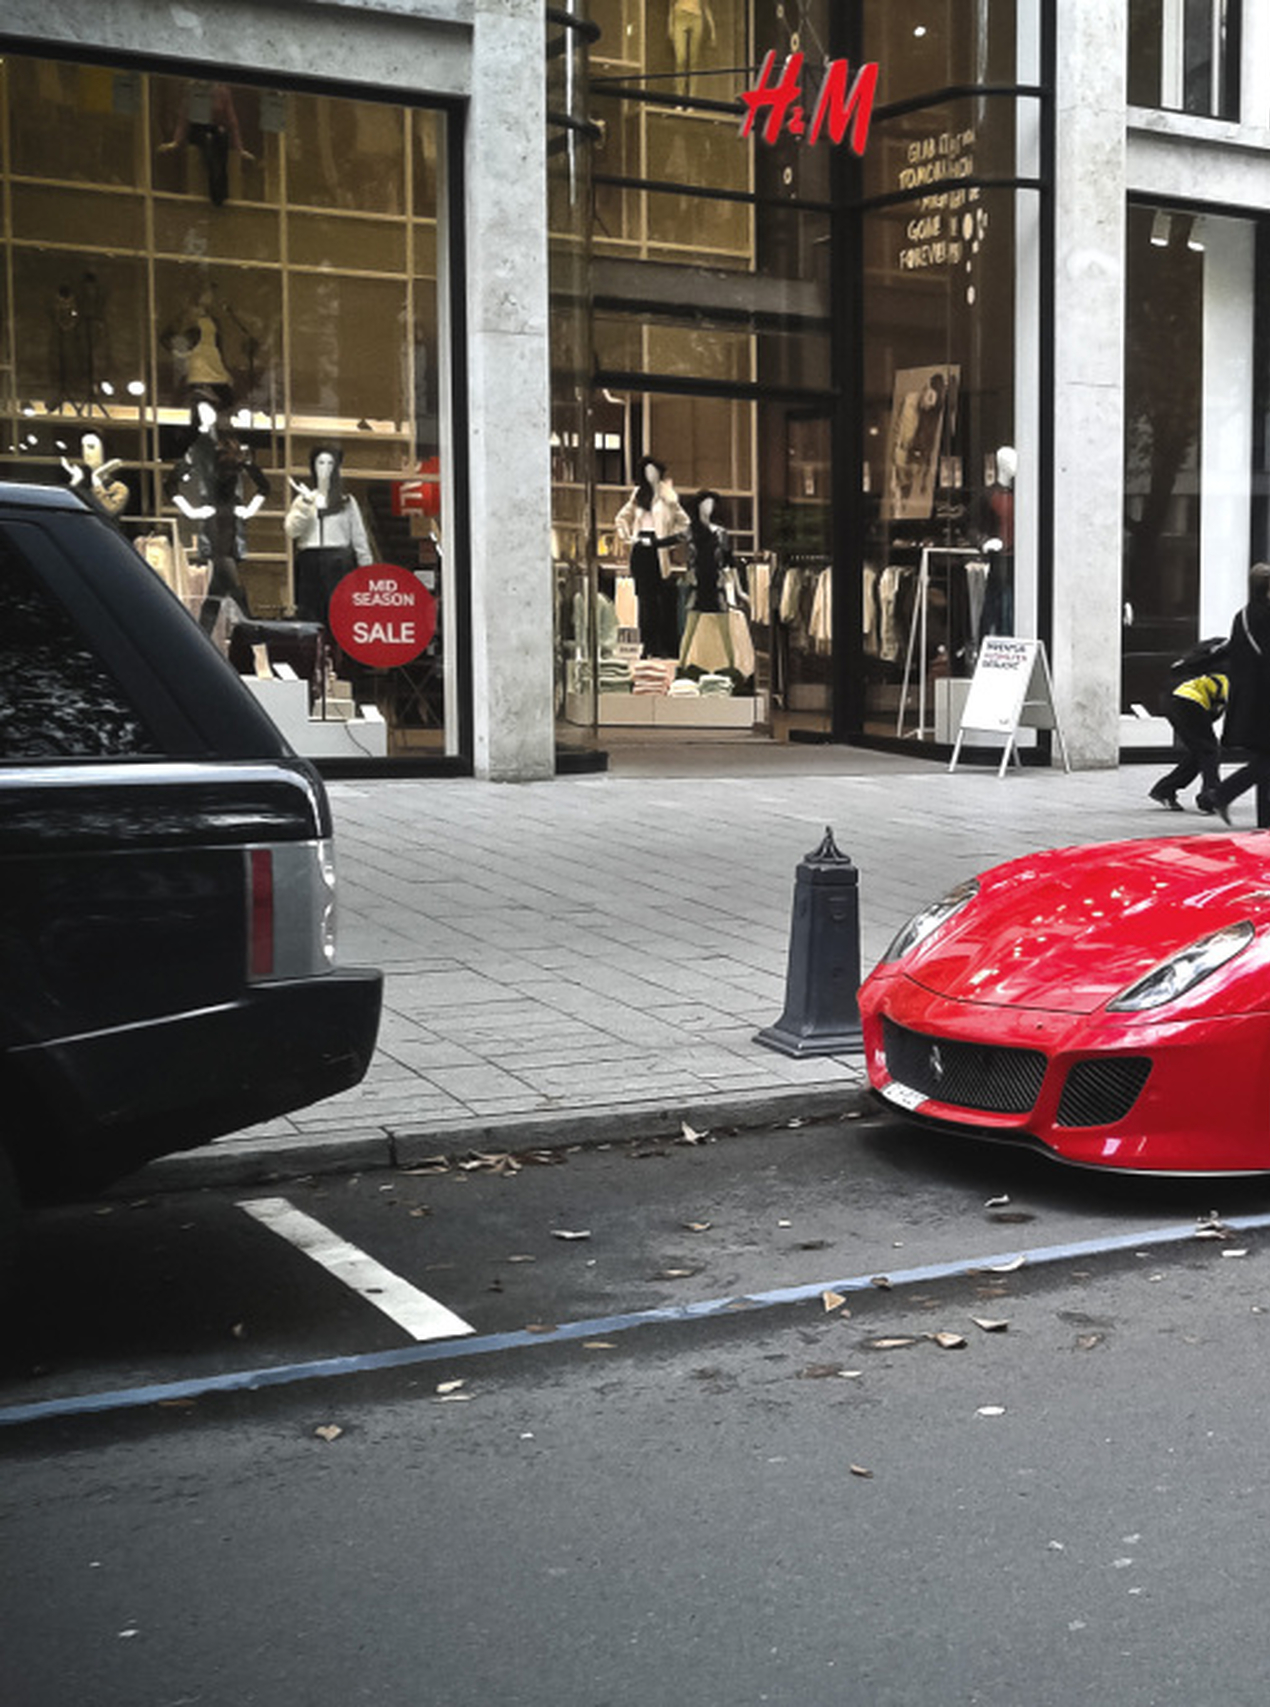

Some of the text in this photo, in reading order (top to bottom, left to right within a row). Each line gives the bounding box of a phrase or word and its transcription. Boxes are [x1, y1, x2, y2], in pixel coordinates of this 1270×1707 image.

[738, 49, 879, 156] H&M
[368, 579, 398, 592] MID
[352, 592, 415, 607] SEASON
[352, 621, 416, 644] SALE
